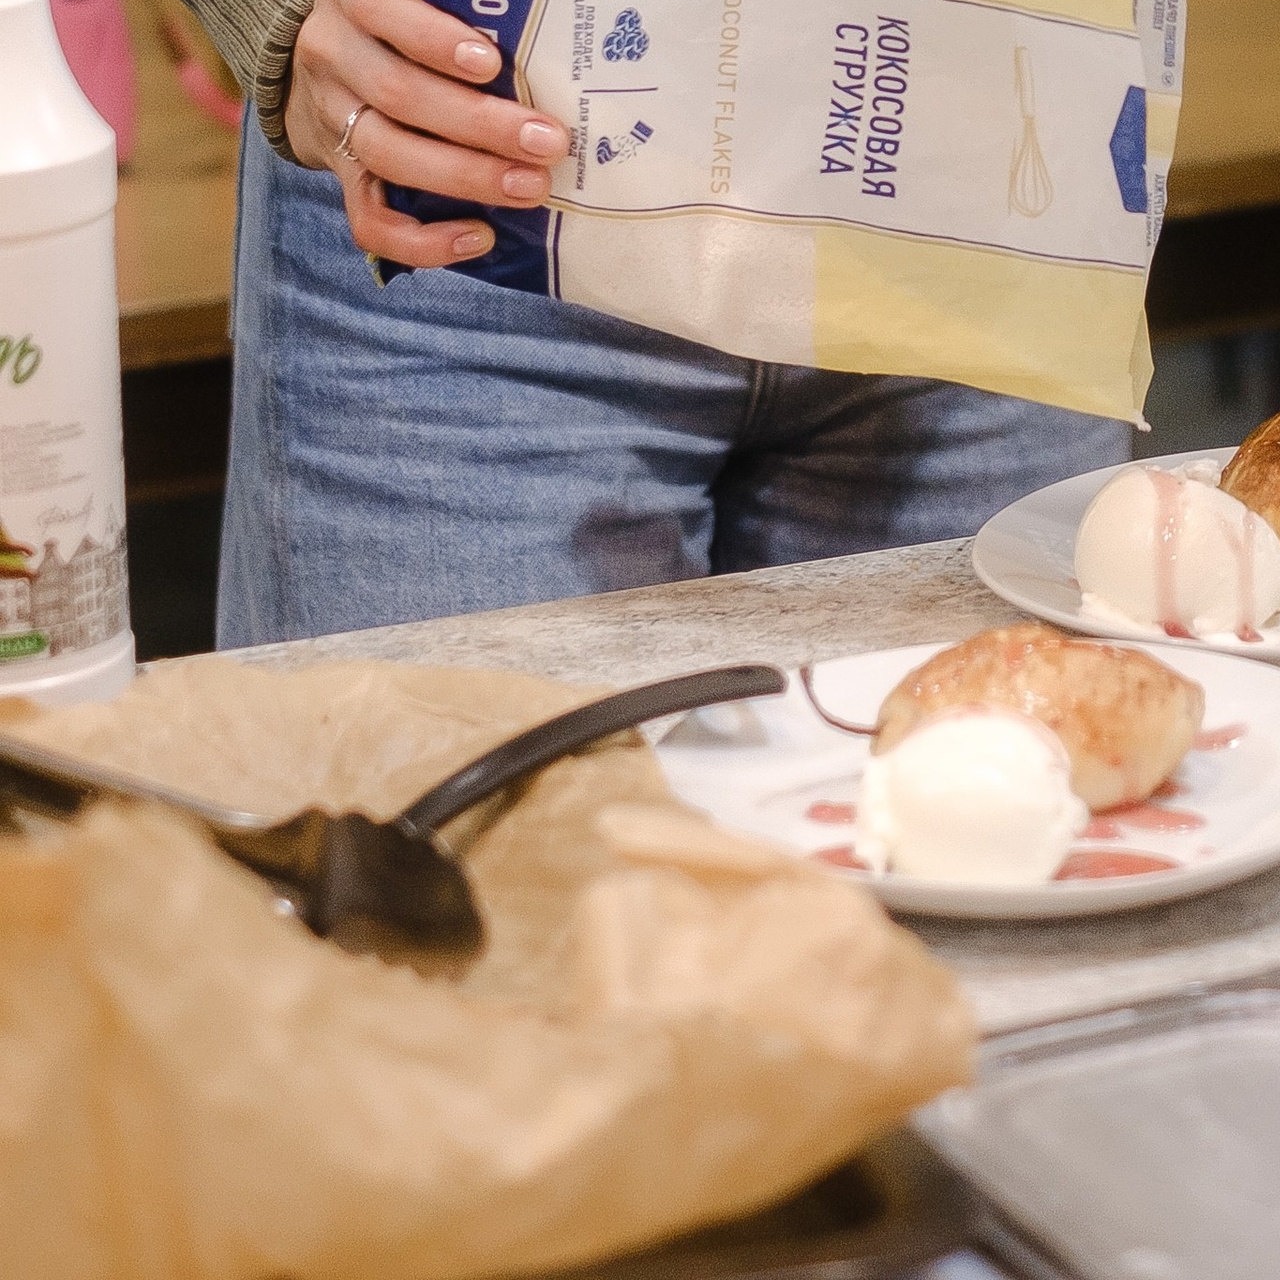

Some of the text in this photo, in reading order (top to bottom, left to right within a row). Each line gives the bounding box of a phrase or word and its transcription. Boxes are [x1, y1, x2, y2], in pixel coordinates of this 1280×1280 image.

[572, 21, 584, 81] ВЫПЕЧКИ
[584, 5, 596, 71] ПОДХОДИТ
[576, 97, 590, 191] ДЛЯ УКРАШЕНИЯ
[820, 23, 869, 174] СТРУЖКА
[861, 14, 910, 198] КОКОСОВАЯ
[710, 100, 736, 194] FLAKES
